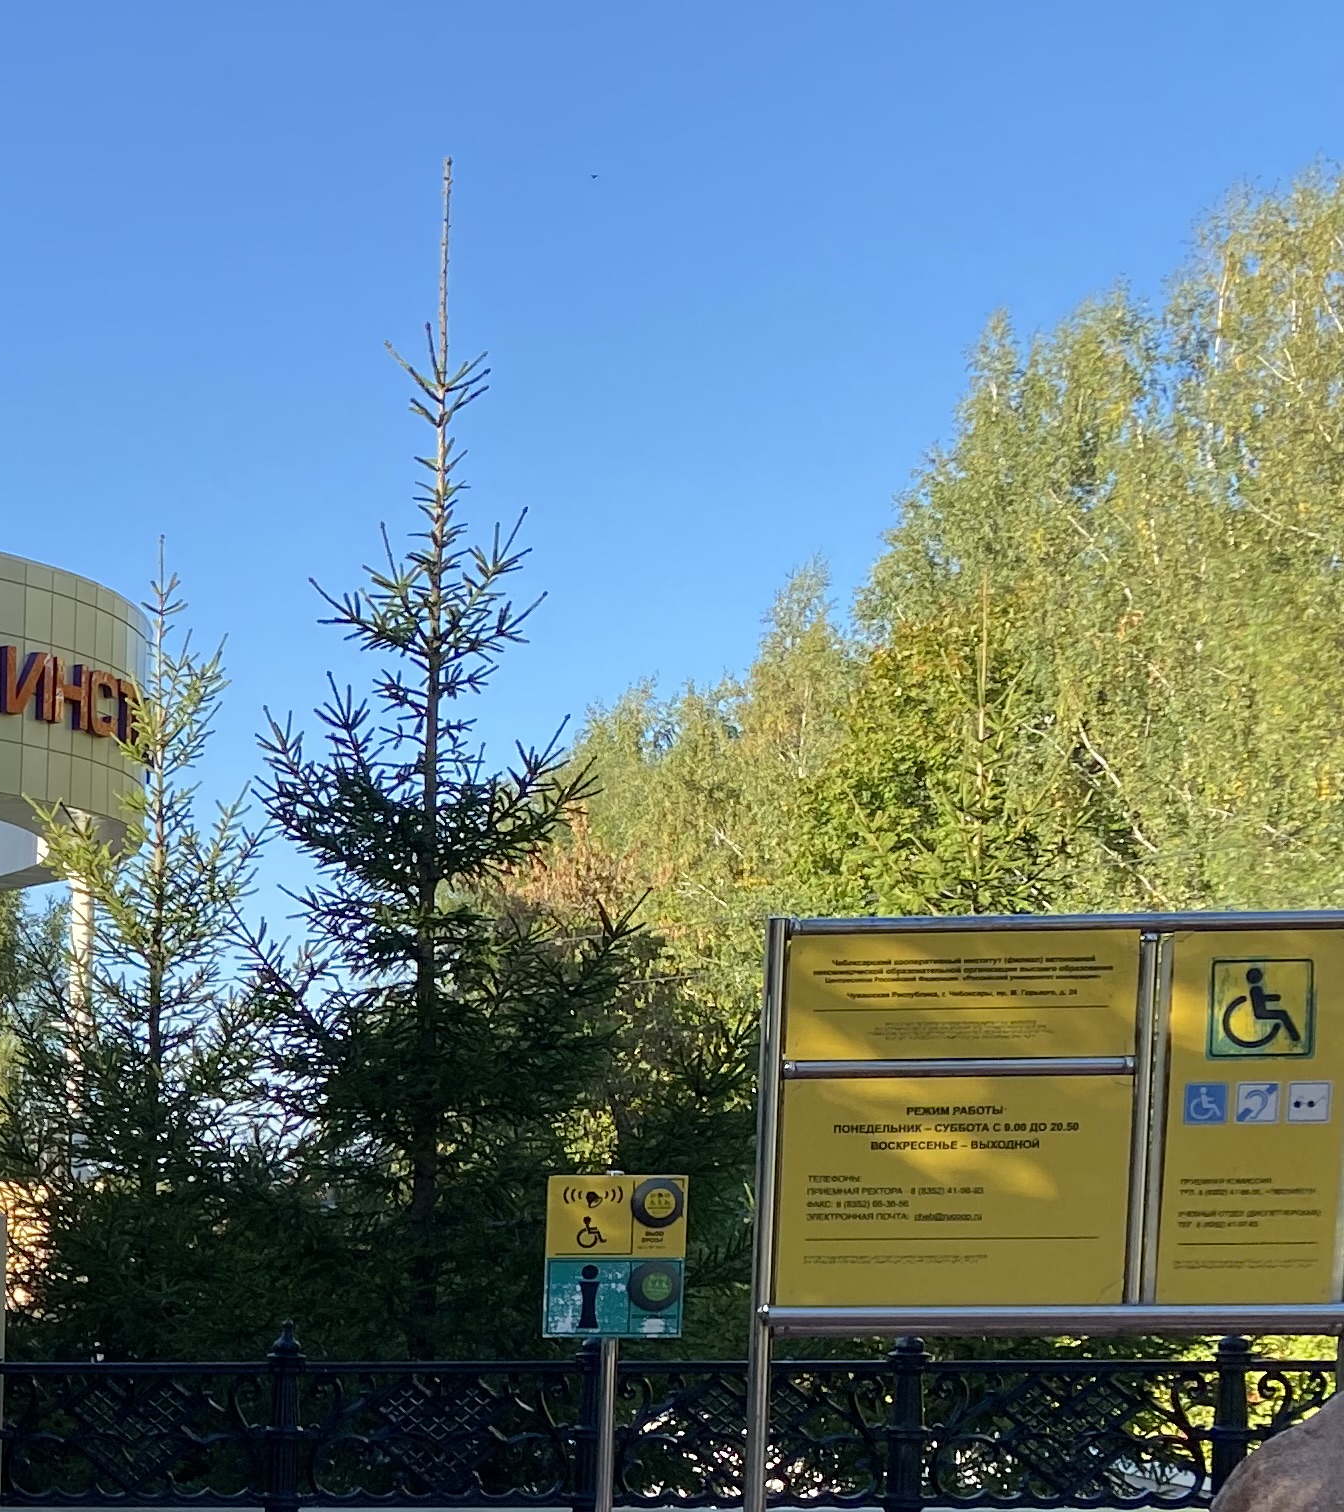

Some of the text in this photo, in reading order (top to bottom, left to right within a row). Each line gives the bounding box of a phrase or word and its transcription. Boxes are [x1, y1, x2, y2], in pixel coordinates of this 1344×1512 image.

[906, 1105, 1005, 1116] РЕЖИМ РАБОТЫ
[833, 1124, 922, 1135] ПОНЕДЕЛЬНИК
[934, 1123, 990, 1133] СУББОТА
[1029, 1122, 1048, 1134] ДО
[870, 1140, 958, 1151] ВОСКРЕСЕНЬЕ
[970, 1138, 1041, 1151] ВЫХОДНОЙ
